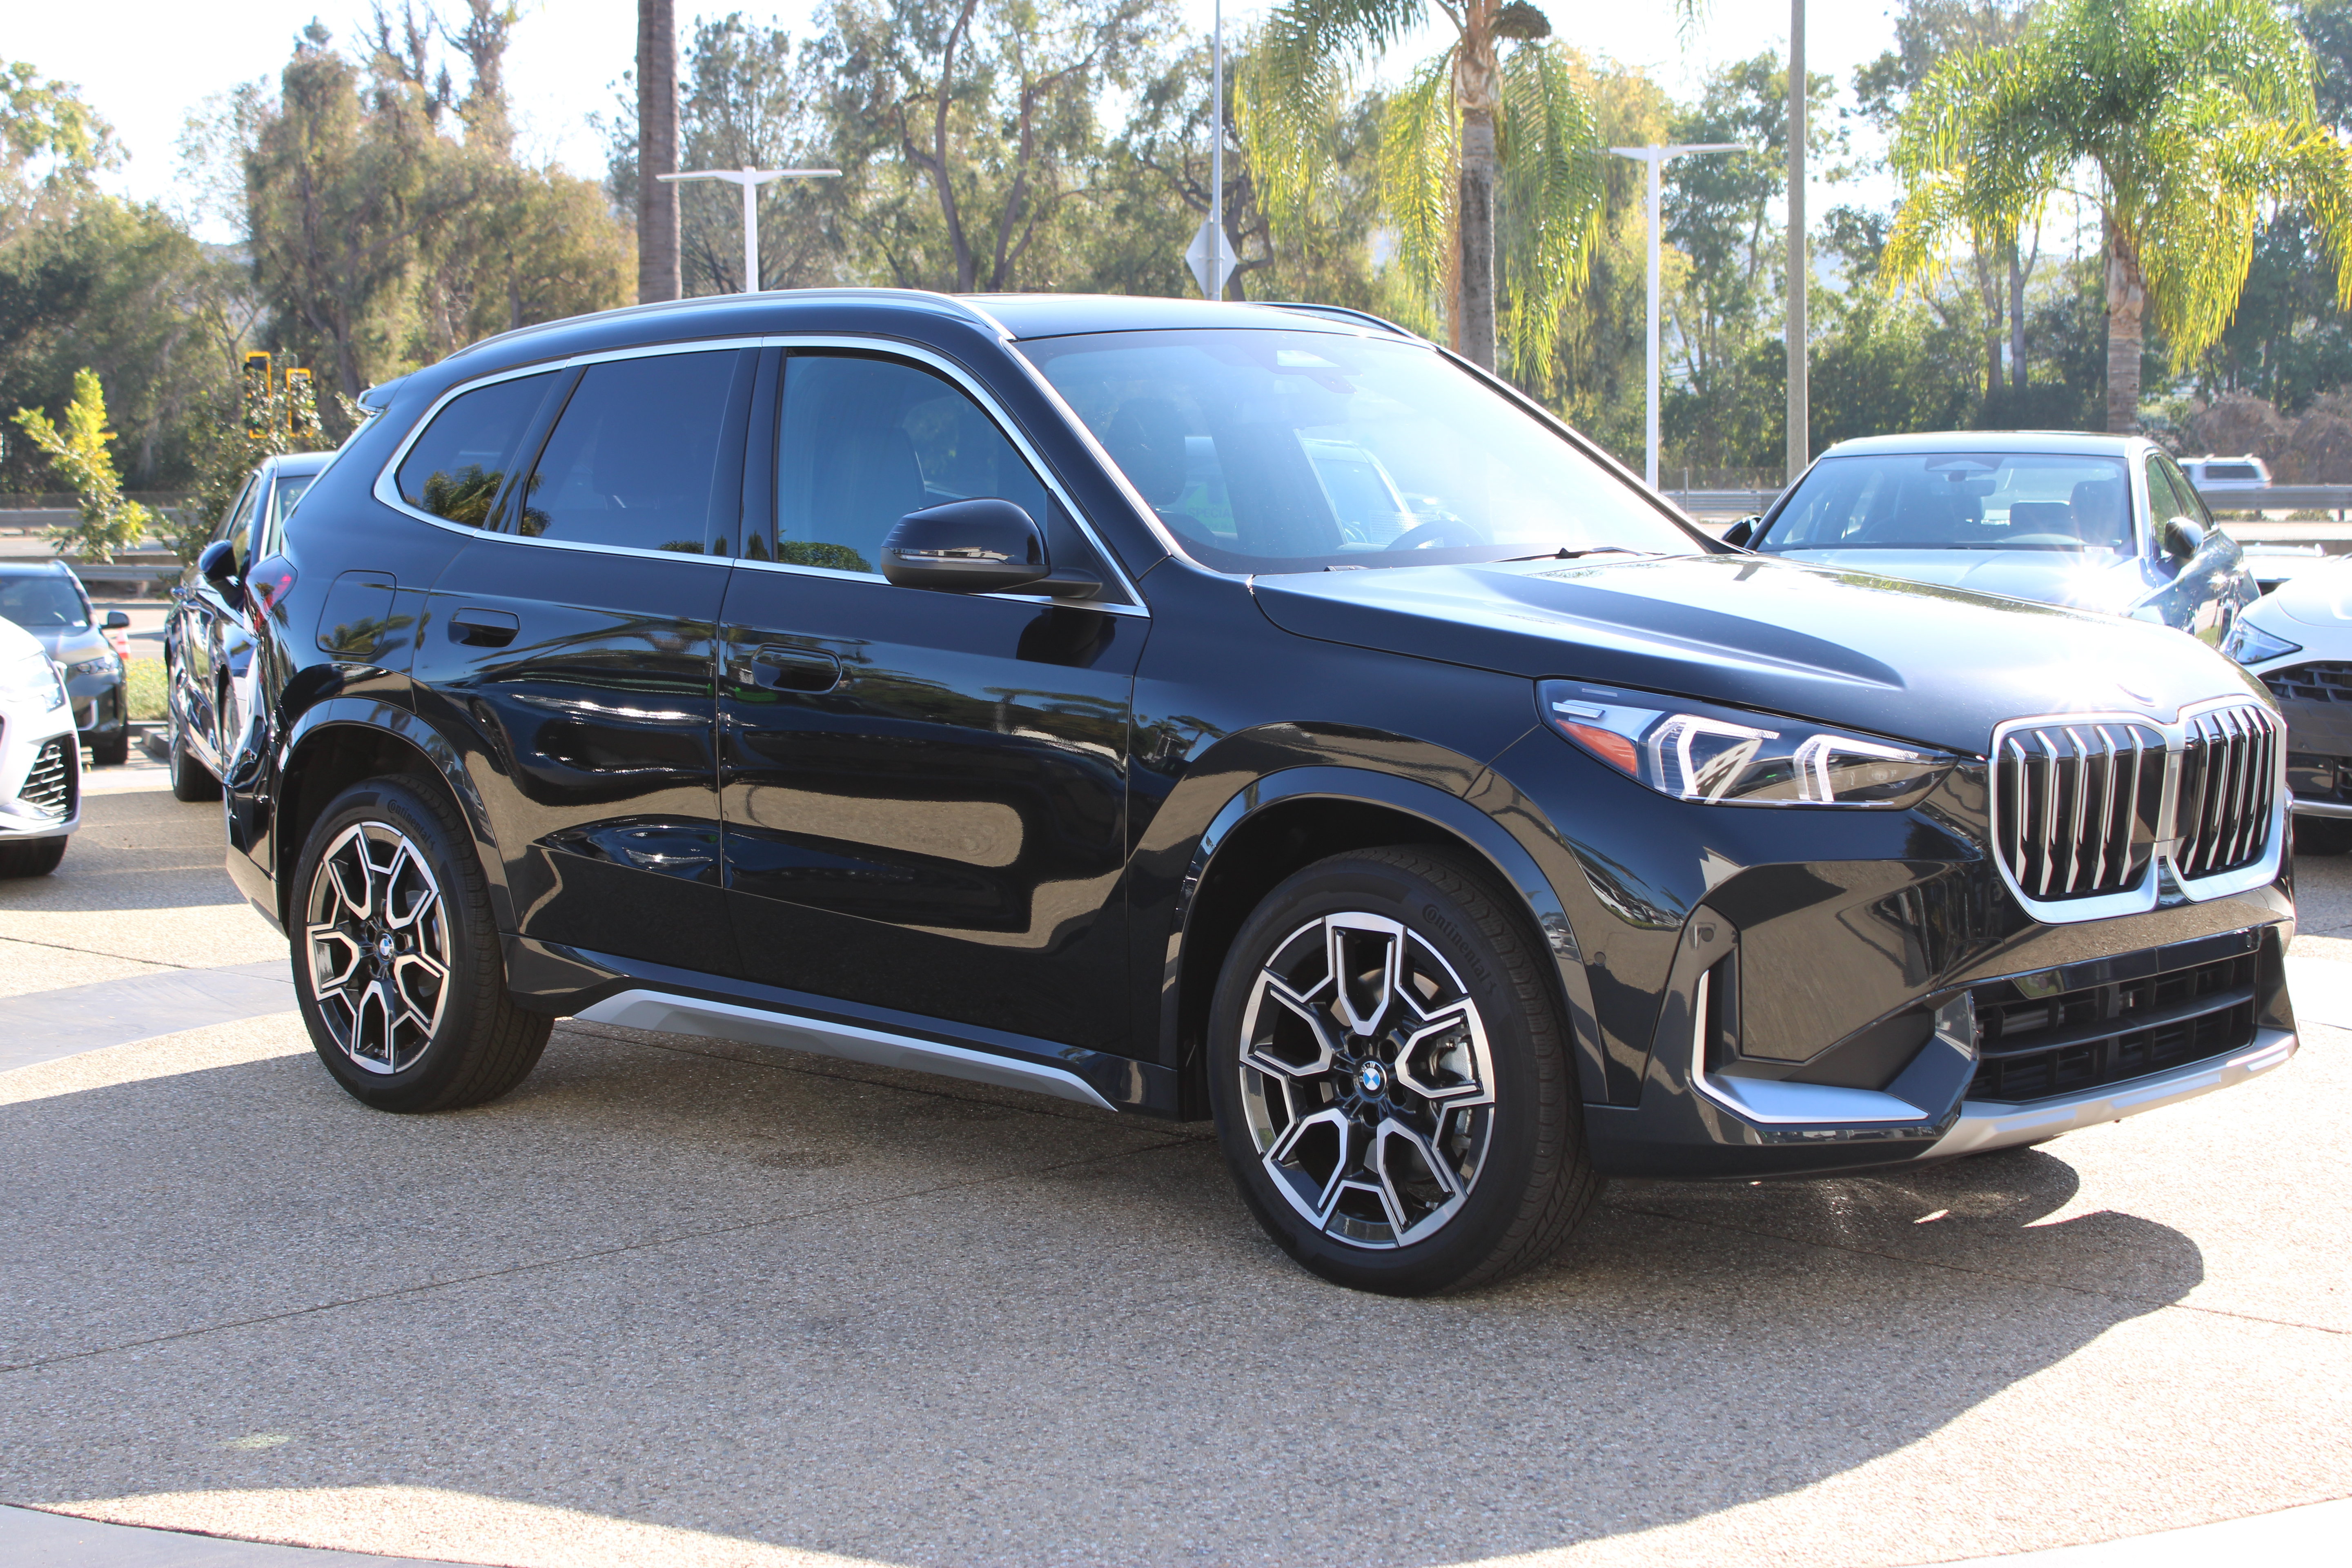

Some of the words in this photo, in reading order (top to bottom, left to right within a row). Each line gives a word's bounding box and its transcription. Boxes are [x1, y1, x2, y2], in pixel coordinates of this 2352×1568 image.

[387, 799, 431, 844] Continental
[1422, 904, 1491, 982] Continental
[1359, 1062, 1376, 1082] BMW
